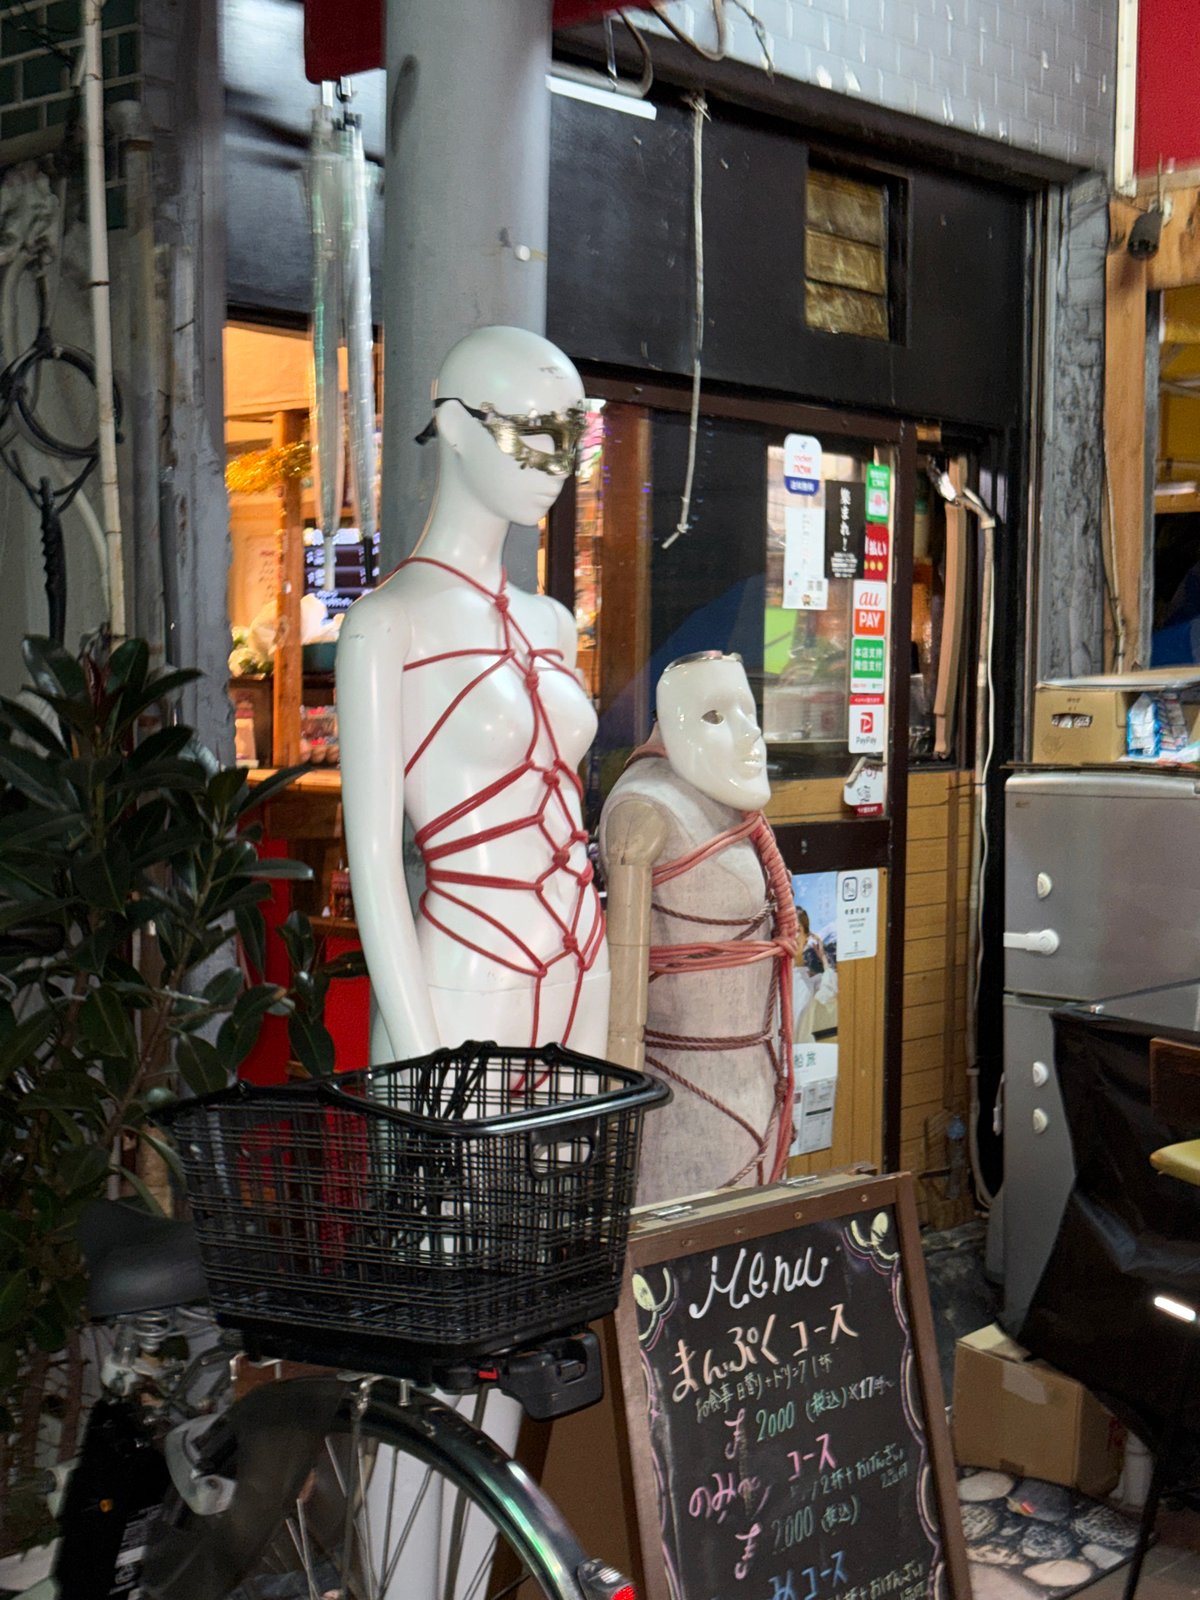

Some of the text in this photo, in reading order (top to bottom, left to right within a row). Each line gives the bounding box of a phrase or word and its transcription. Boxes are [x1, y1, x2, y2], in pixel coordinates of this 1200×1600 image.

[859, 591, 881, 607] au
[858, 611, 881, 629] PAY
[855, 736, 878, 746] PayPay
[689, 1247, 829, 1319] Menu
